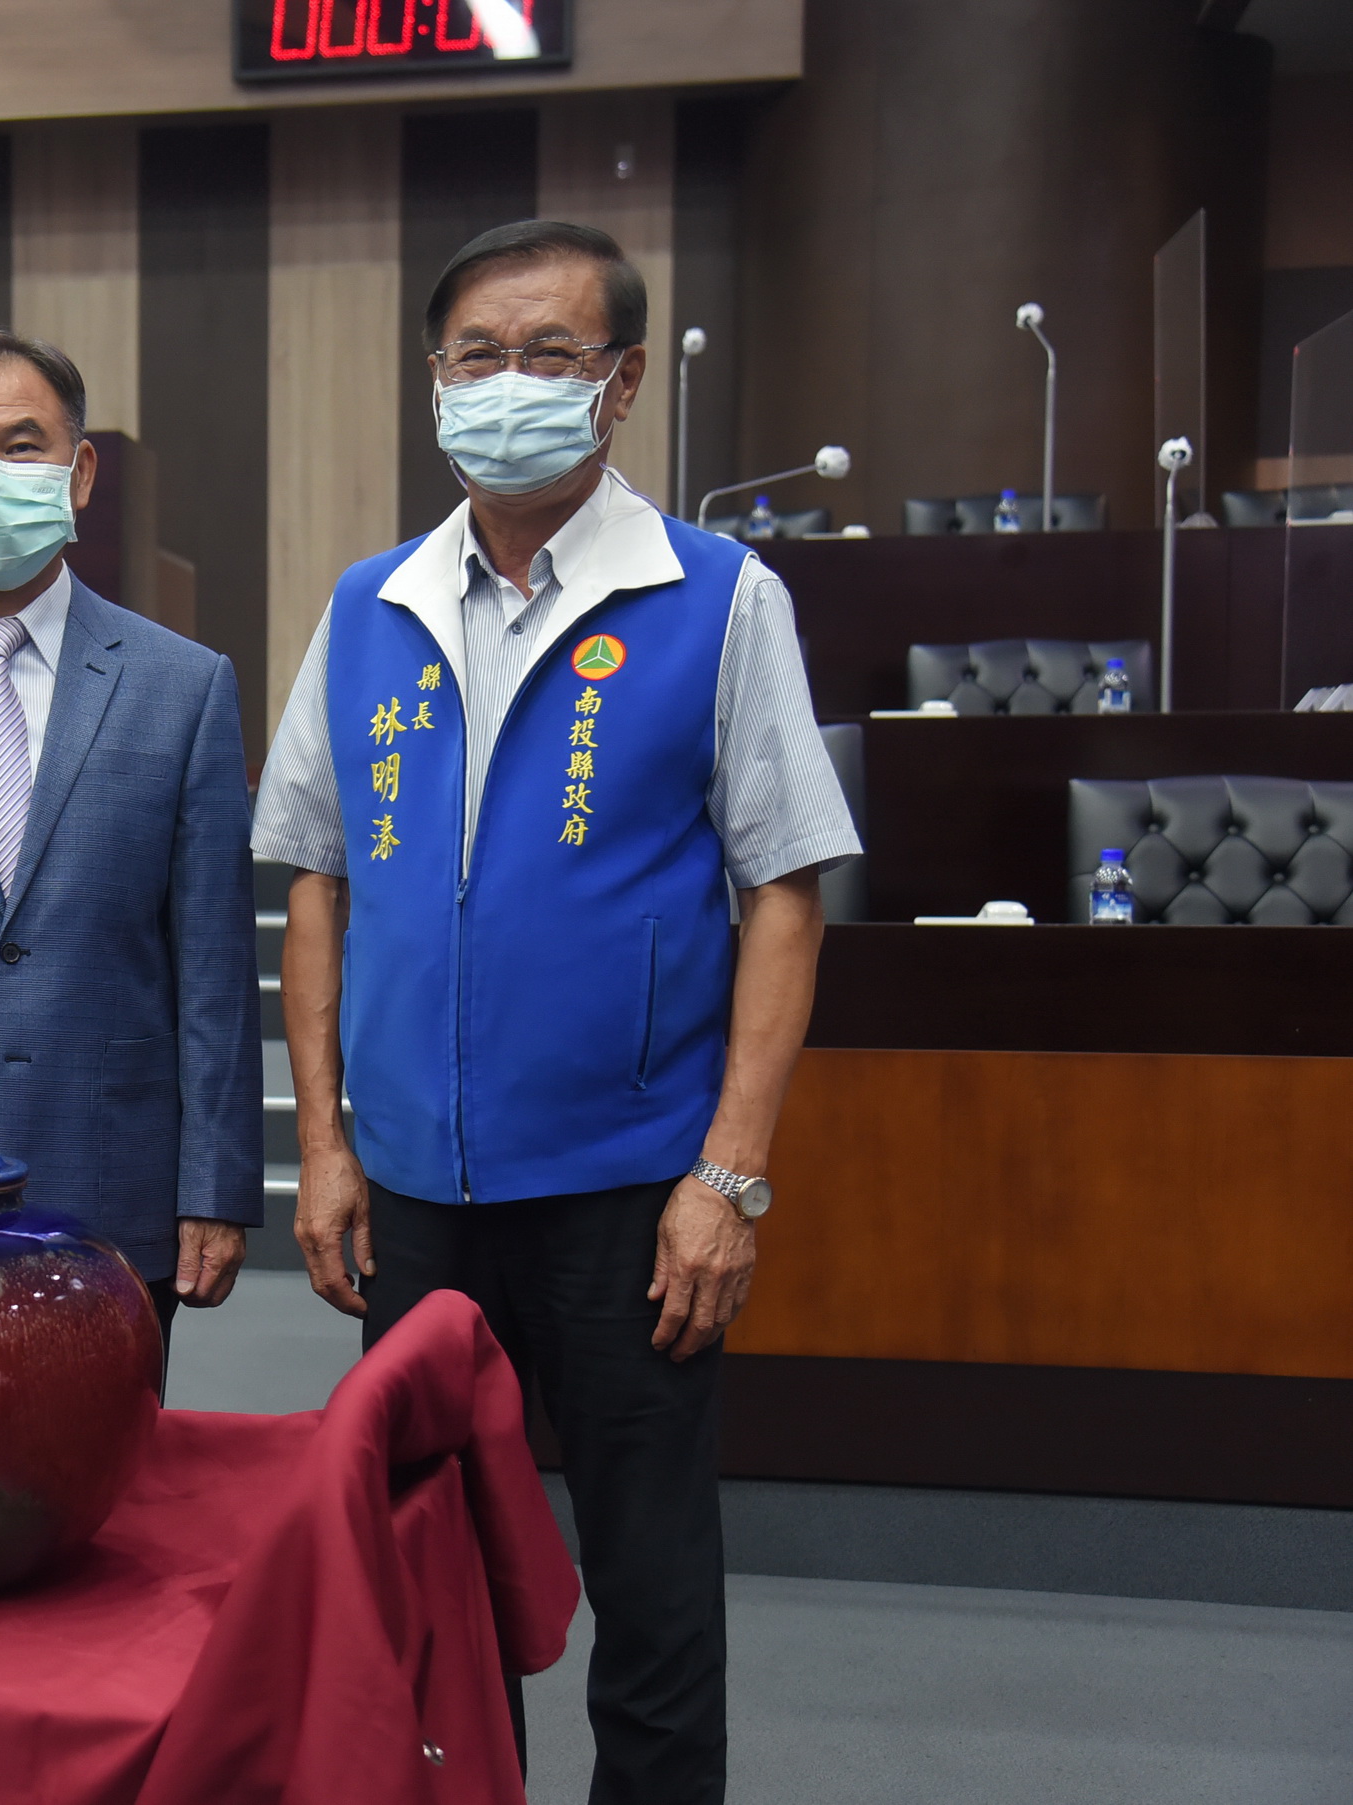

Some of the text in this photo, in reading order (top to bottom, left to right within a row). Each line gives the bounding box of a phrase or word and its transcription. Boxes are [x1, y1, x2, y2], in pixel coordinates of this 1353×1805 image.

[411, 662, 442, 730] 縣長
[558, 685, 603, 847] 南投縣政府
[368, 697, 408, 861] 林明溱
